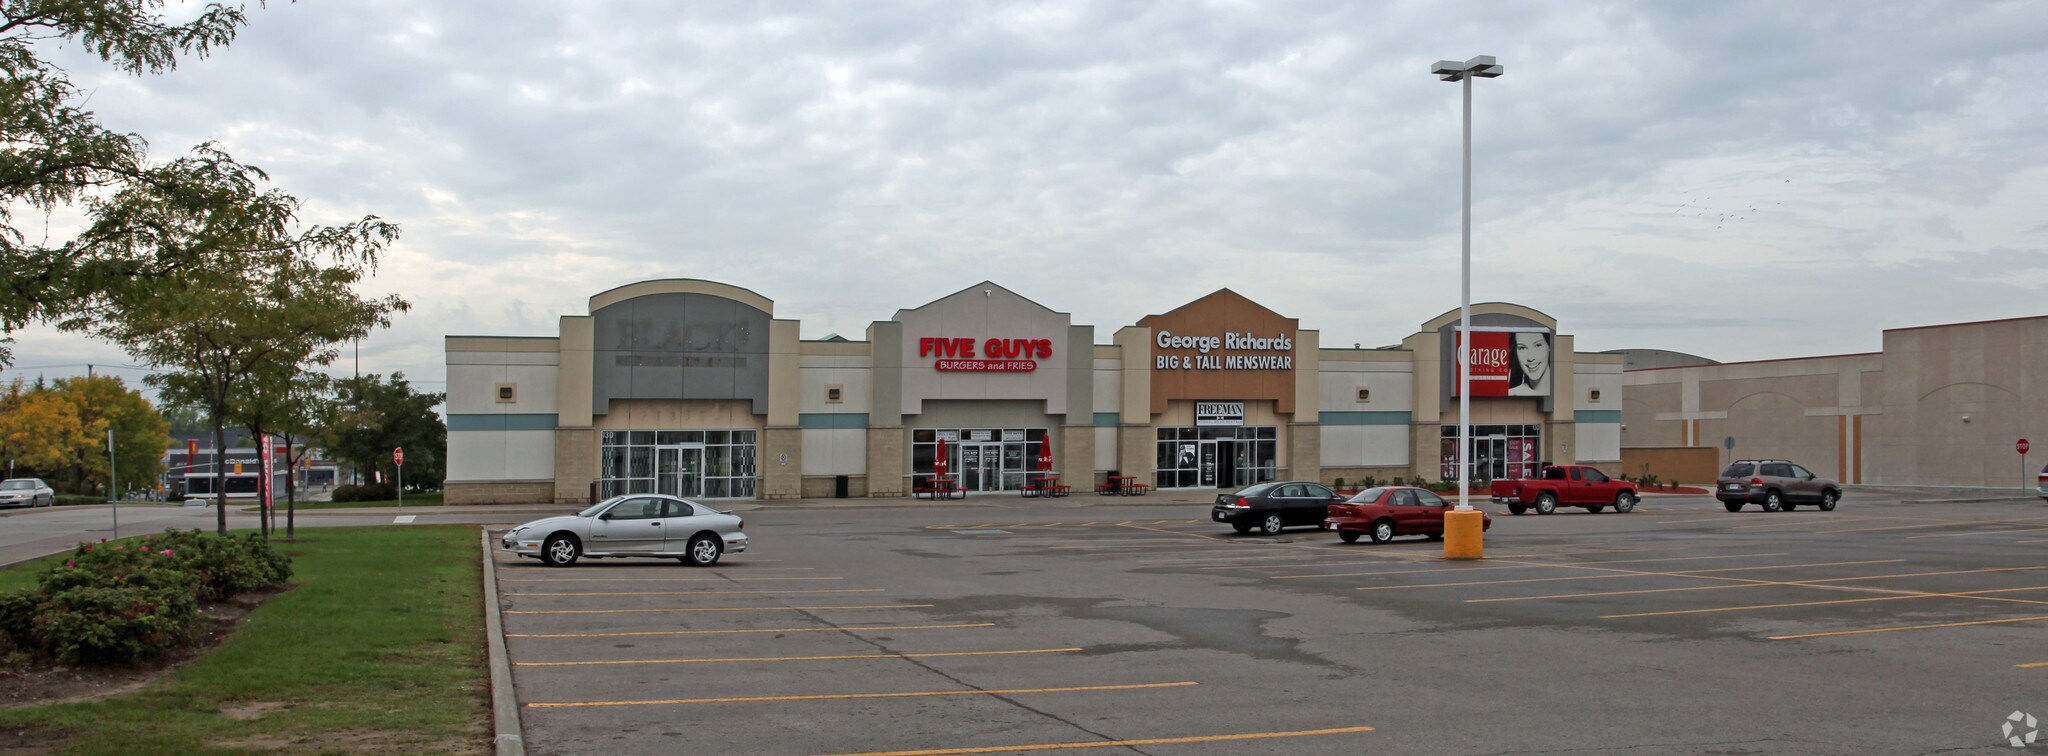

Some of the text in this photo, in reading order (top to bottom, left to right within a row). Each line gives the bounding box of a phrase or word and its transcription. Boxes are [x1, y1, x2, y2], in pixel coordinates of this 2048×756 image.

[920, 337, 1053, 358] FIVE GUYS
[1157, 330, 1292, 353] George Richards
[1157, 356, 1292, 369] BIG & TALL MENSWEAR
[1457, 344, 1508, 367] arage
[940, 361, 1034, 370] BURGERS and FRIES
[1198, 404, 1242, 414] FREEMAN
